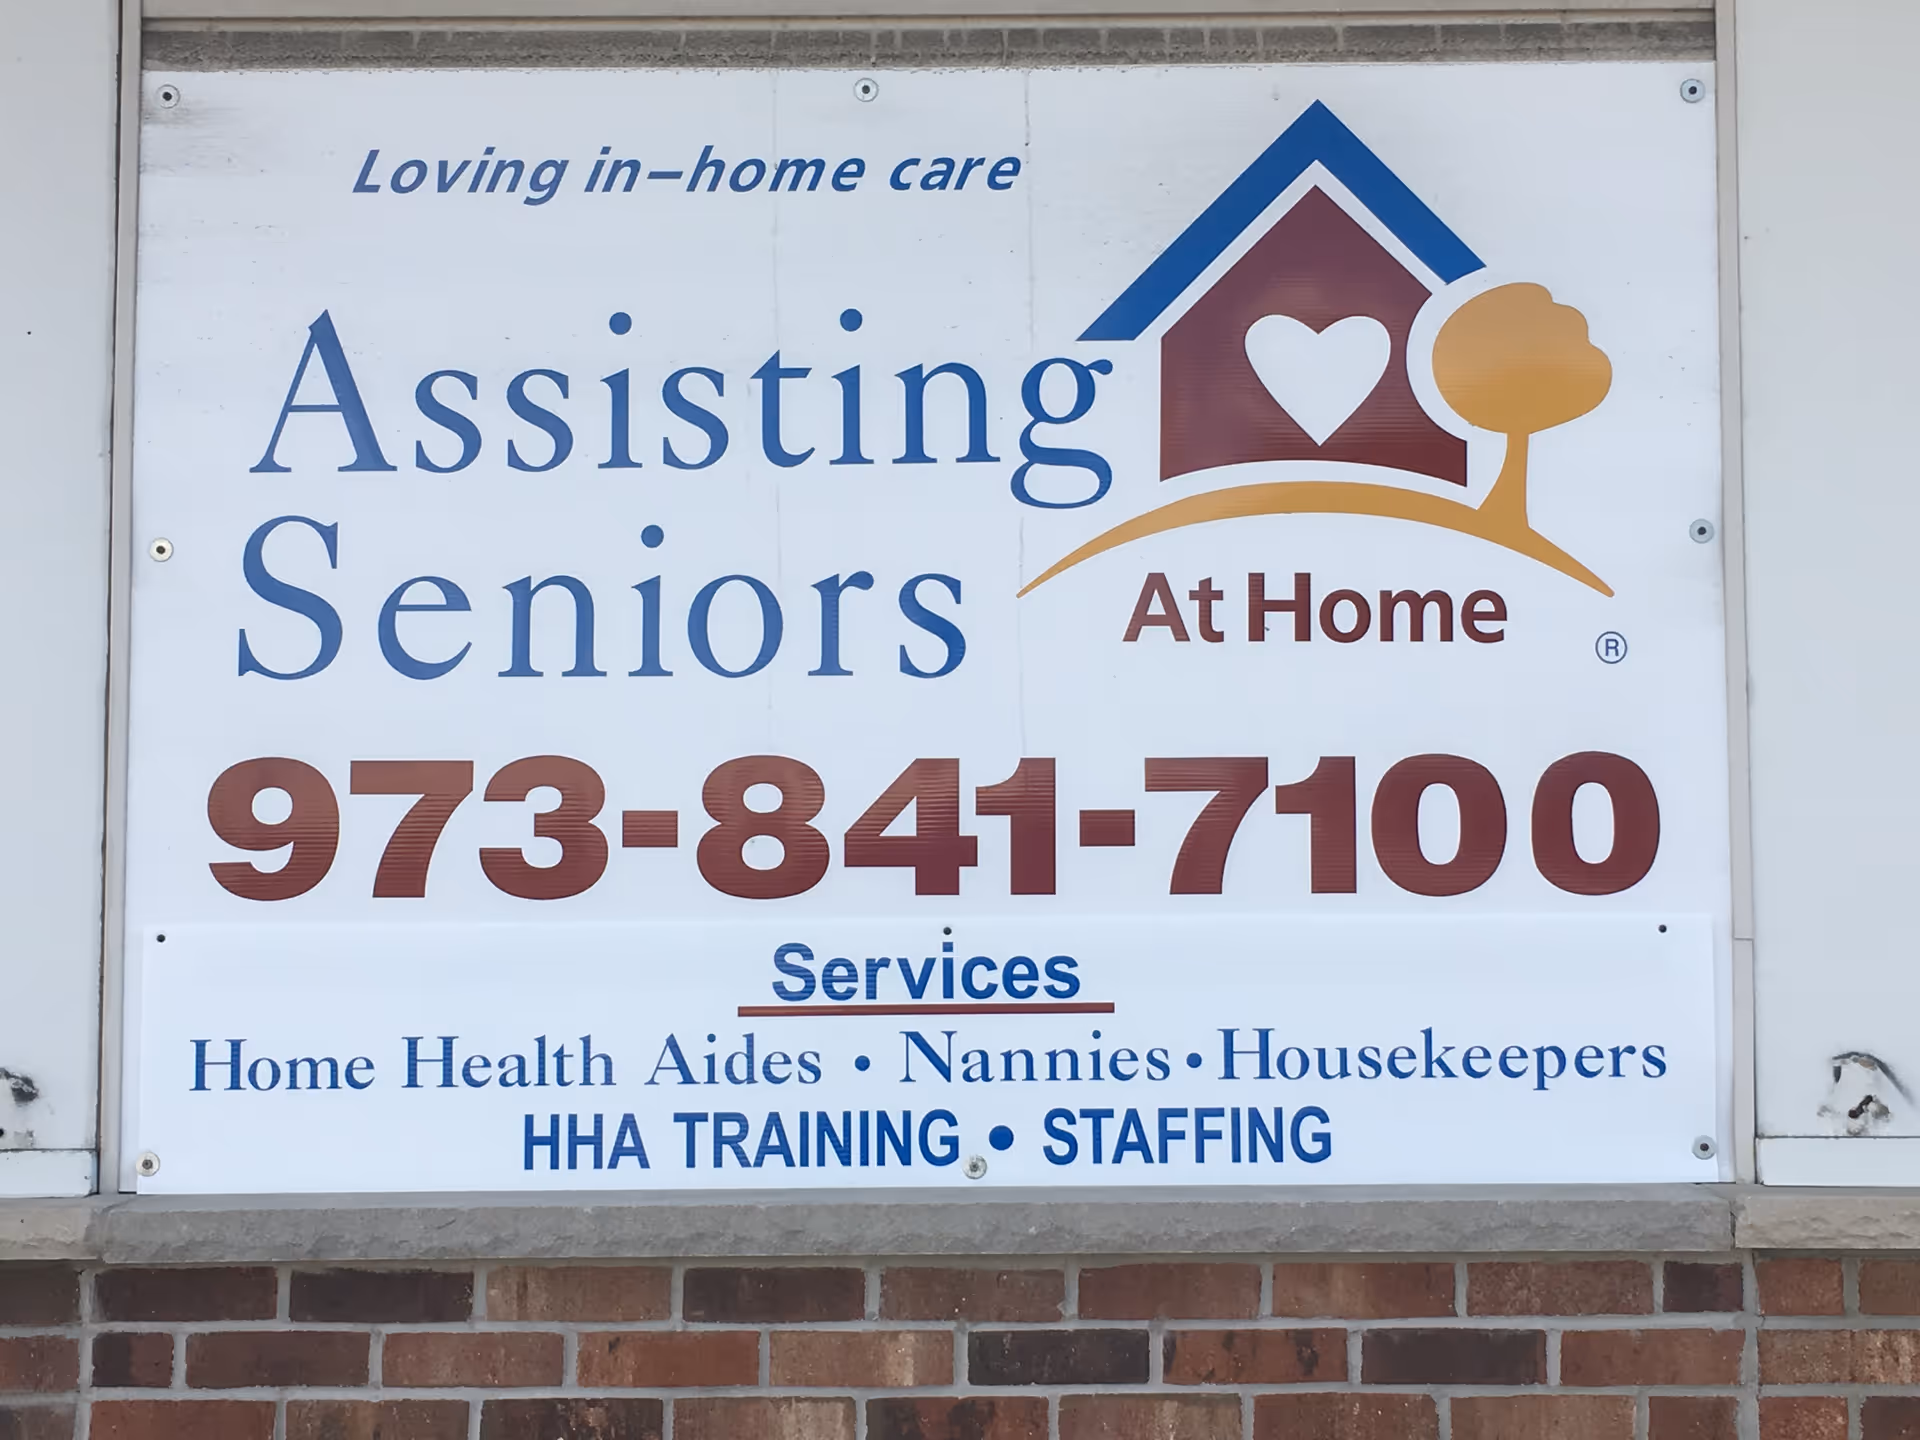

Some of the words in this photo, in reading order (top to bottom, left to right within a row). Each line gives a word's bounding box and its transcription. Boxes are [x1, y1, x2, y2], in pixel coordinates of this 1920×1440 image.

[353, 147, 567, 206] Loving
[585, 145, 866, 193] in-home
[888, 153, 1022, 191] care
[249, 308, 1113, 509] Assisting
[237, 515, 966, 681] Seniors
[1122, 572, 1224, 644] At
[1248, 572, 1508, 644] Home
[206, 751, 1661, 902] 973-841-7100
[771, 940, 1082, 1003] Services
[189, 1038, 376, 1092] Home
[401, 1035, 616, 1090] Health
[643, 1032, 822, 1088] Aides
[898, 1029, 1172, 1084] Nannies
[1217, 1026, 1668, 1092] Housekeepers
[522, 1112, 651, 1171] HHA
[673, 1107, 961, 1170] TRAINING
[1042, 1105, 1333, 1167] STAFFING
